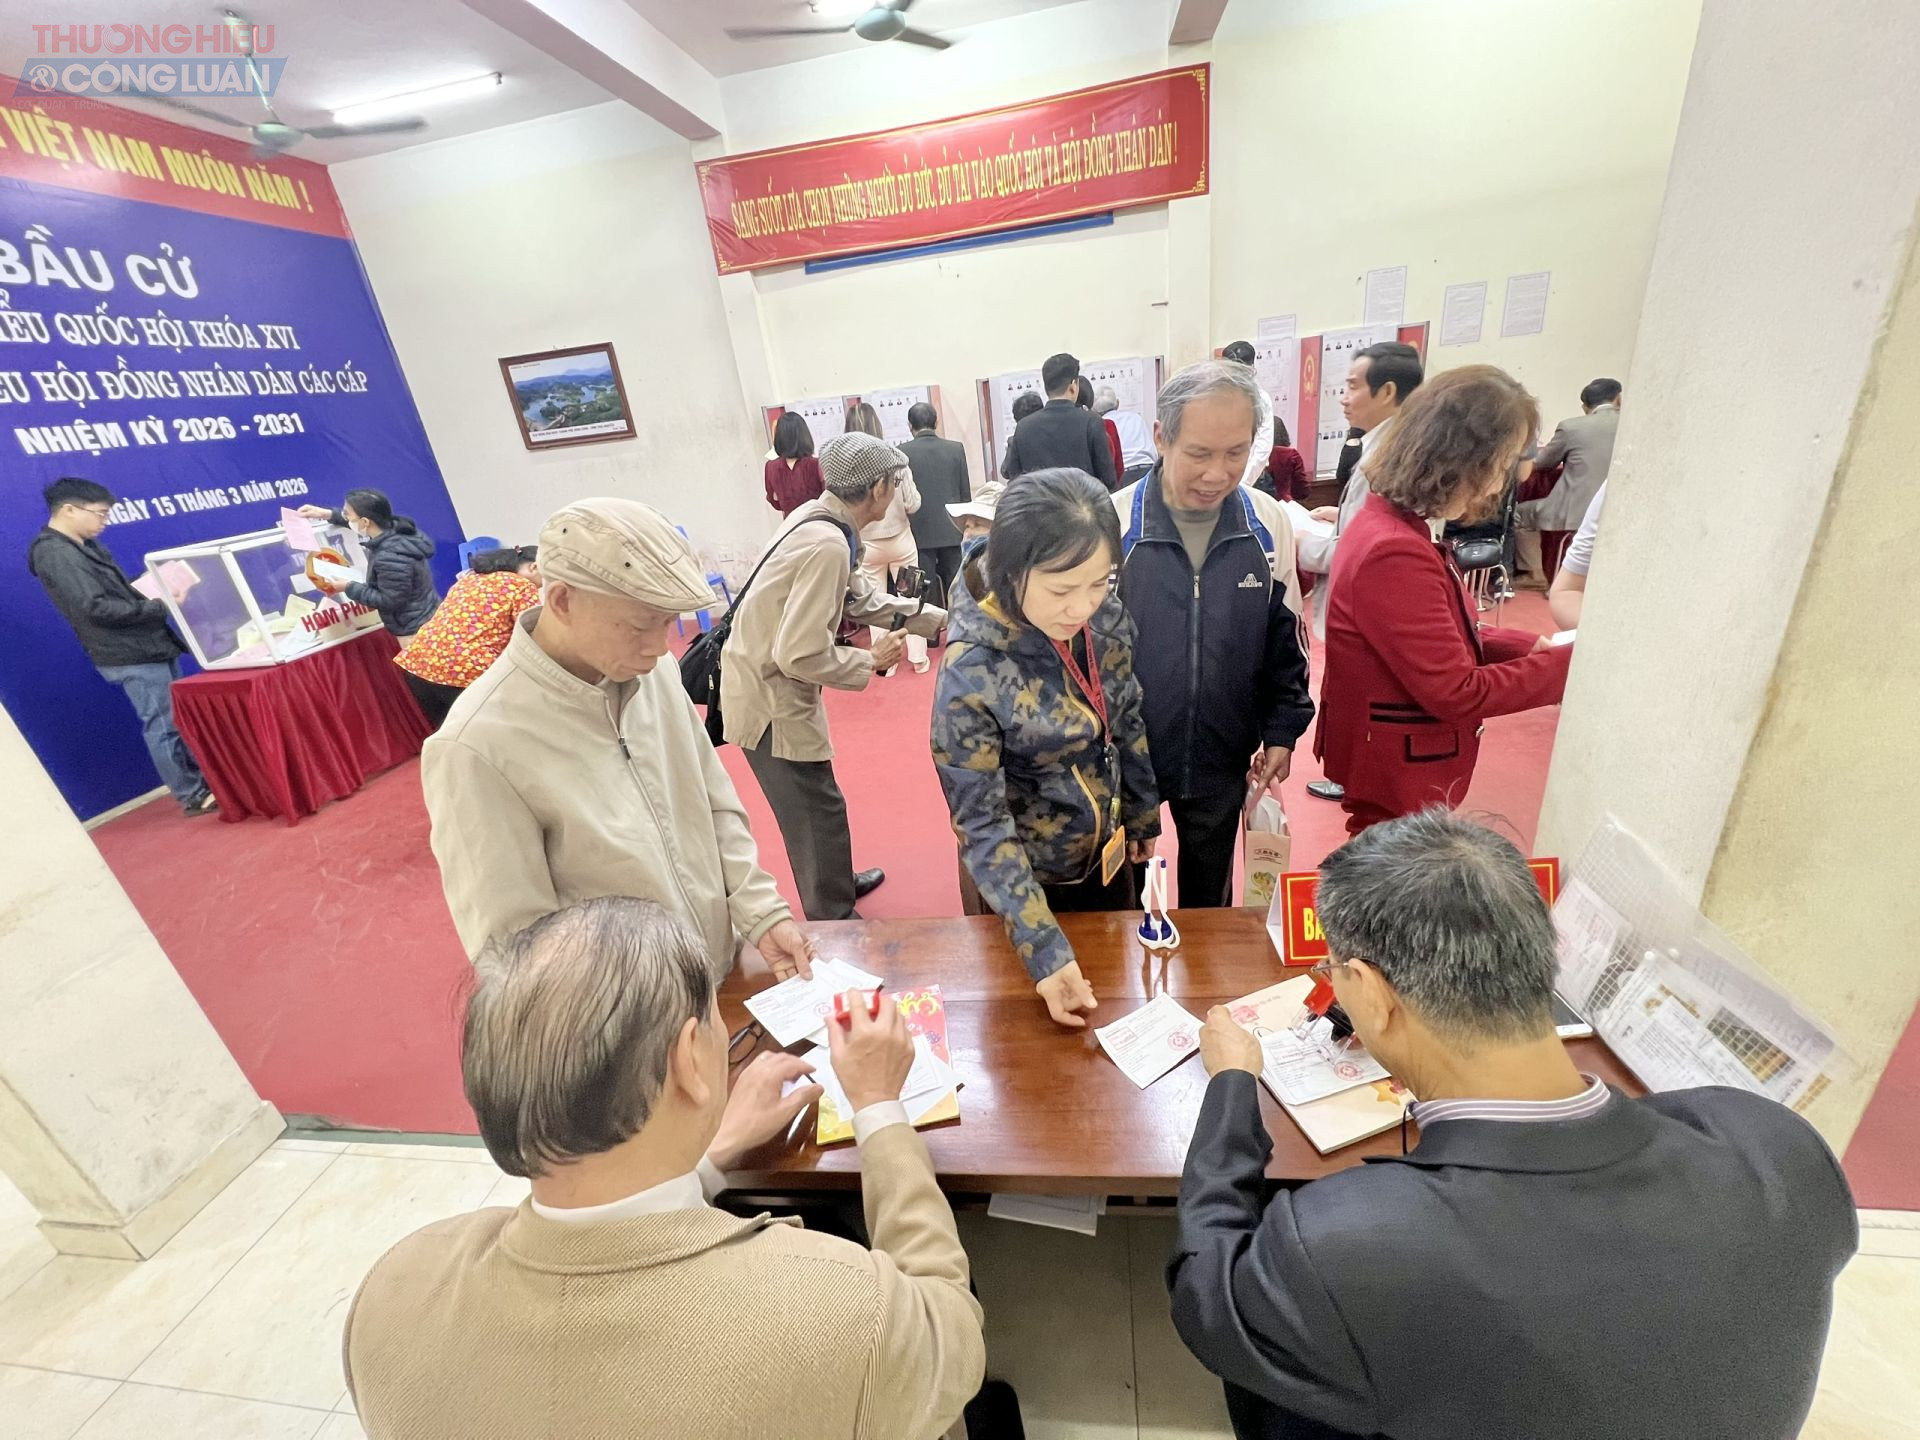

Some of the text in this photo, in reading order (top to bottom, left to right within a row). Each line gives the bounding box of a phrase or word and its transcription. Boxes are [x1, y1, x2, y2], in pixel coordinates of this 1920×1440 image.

[0, 106, 84, 170] VIỆT
[82, 127, 165, 182] NAM
[159, 148, 246, 198] MUÔN
[242, 163, 301, 210] NĂM
[731, 188, 760, 239] SÁNG
[757, 175, 785, 235] SUỐT
[782, 186, 805, 240] LỰA
[803, 187, 834, 237] CHỌN
[830, 171, 867, 224] NHỮNG
[865, 161, 899, 218] NGƯỜI
[897, 152, 913, 214] ĐỦ
[936, 144, 952, 206] ĐỦ
[952, 149, 972, 203] TÀI
[971, 145, 994, 199] VÀO
[994, 131, 1024, 198] QUỐC
[1023, 133, 1044, 200] HỘI
[1044, 131, 1061, 187] VÀ
[1060, 127, 1082, 192] HỘI
[1083, 112, 1114, 179] ĐỒNG
[1114, 113, 1146, 174] NHÂN
[1148, 108, 1172, 168] DÂN
[0, 223, 199, 299] BẦU CỬ
[55, 301, 139, 347] QUỐC
[137, 309, 192, 354] HỘI
[189, 314, 260, 350] KHÓA
[258, 323, 300, 351] XVI
[31, 360, 100, 408] HỘI
[96, 355, 182, 400] ĐỒNG
[179, 362, 252, 397] NHÂN
[250, 361, 298, 396] DÂN
[299, 362, 337, 395] CÁC
[338, 359, 368, 394] CẤP
[14, 418, 129, 457] NHIỆM
[128, 414, 169, 447] KỲ
[172, 416, 237, 443] 2026
[253, 411, 305, 436] 2031
[151, 495, 177, 517] 15
[173, 486, 230, 513] THÁNG
[228, 486, 242, 505] 3
[239, 479, 277, 504] NĂM
[274, 477, 309, 497] 2026
